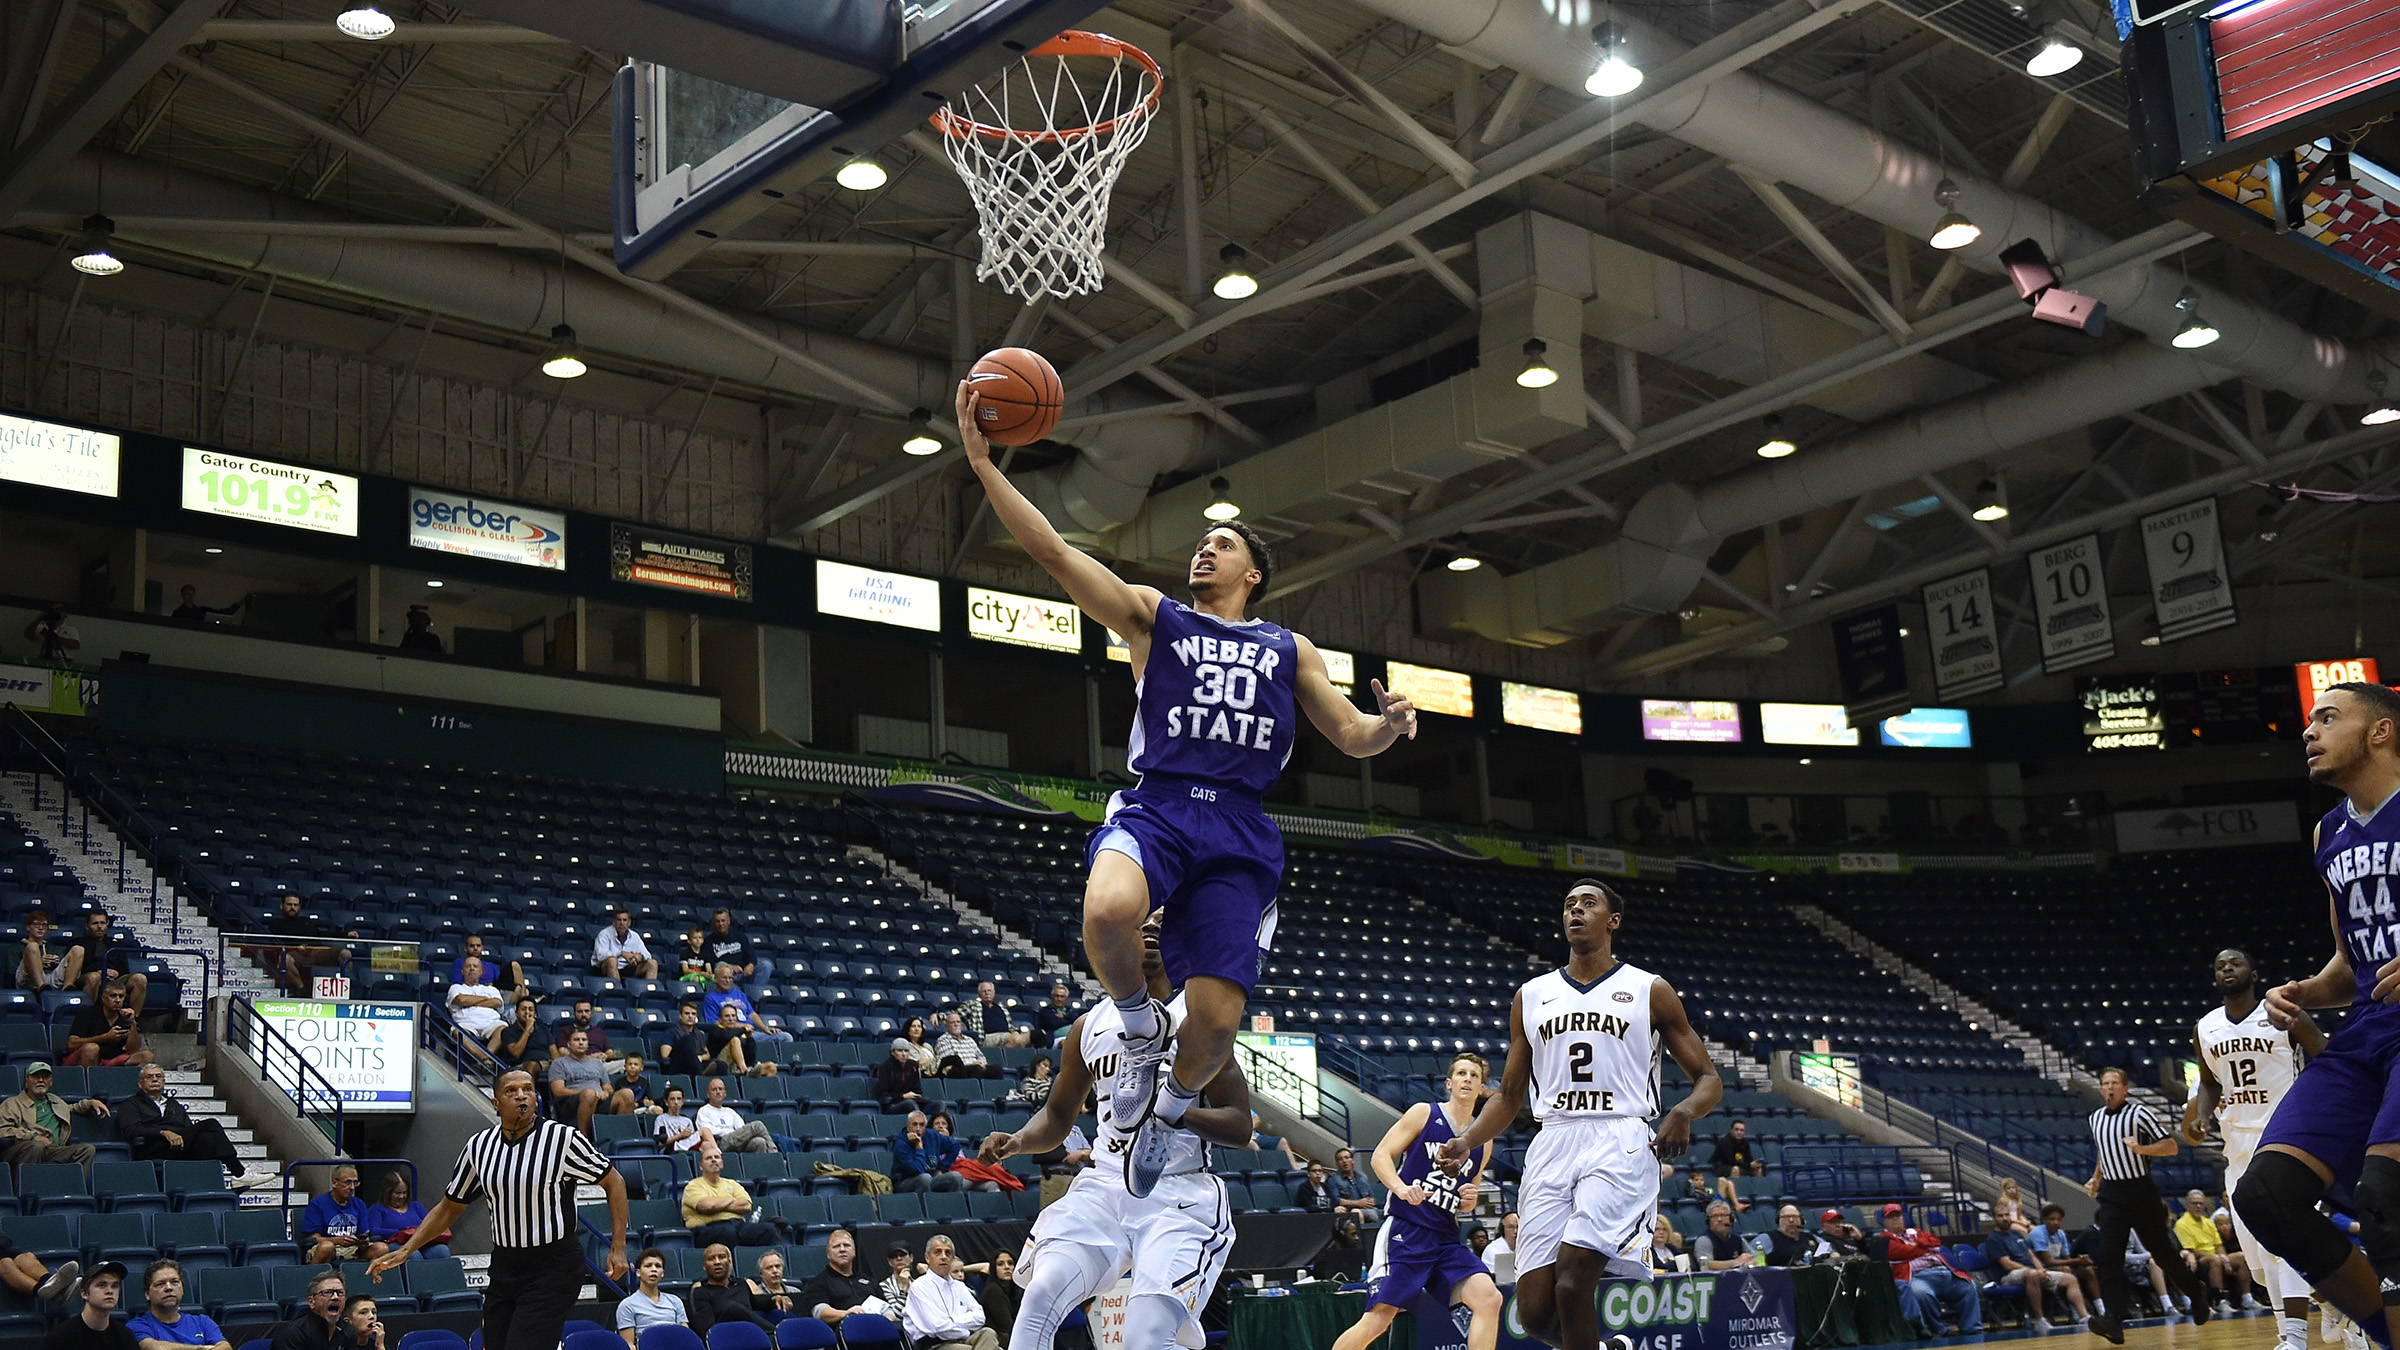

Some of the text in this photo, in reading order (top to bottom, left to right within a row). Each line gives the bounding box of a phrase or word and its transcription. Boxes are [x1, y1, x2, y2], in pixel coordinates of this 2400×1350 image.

[201, 454, 310, 484] Gator Country
[200, 470, 310, 516] 101.9
[314, 511, 339, 522] FM
[413, 498, 521, 533] gerber
[432, 522, 516, 543] COLLISION & GLASS
[412, 537, 441, 551] Highly
[443, 543, 523, 563] Wreck-ommended!
[2044, 544, 2086, 567] BERG
[2172, 531, 2194, 568] 9
[636, 567, 731, 593] GermainAutoImages.com
[865, 577, 893, 590] USA
[1928, 578, 1984, 602] BUCKLEY
[2046, 563, 2091, 605] 10
[849, 588, 911, 607] GRADING
[1939, 595, 1981, 636] 14
[1170, 635, 1280, 681] WEBER
[2309, 661, 2367, 690] BOB
[1192, 663, 1258, 711] 30
[2097, 687, 2155, 708] Jack's
[431, 714, 455, 730] 111
[2098, 706, 2148, 719] Cleaning
[1167, 705, 1276, 752] STATE
[2100, 717, 2146, 730] Services
[1090, 790, 1107, 803] 112
[1190, 786, 1217, 803] CATS
[2202, 809, 2258, 835] FCB
[93, 858, 120, 866] metro
[124, 886, 152, 894] metro
[2349, 877, 2396, 925] 44
[176, 937, 203, 945] metro
[222, 978, 248, 987] metro
[322, 979, 345, 997] EXIT
[231, 989, 260, 998] metro
[264, 1003, 406, 1018] Section 110 111 Section
[284, 1019, 358, 1042] FOUR
[1257, 1017, 1271, 1031] EXIT
[1538, 1011, 1631, 1046] MURRAY
[1248, 1036, 1261, 1045] 111
[1275, 1036, 1290, 1046] 112
[2209, 1038, 2275, 1060] MURRAY
[284, 1046, 385, 1070] POINTS
[1569, 1042, 1594, 1083] 2
[307, 1072, 385, 1085] SERATON
[2230, 1058, 2257, 1088] 12
[1553, 1090, 1614, 1111] STATE
[2228, 1090, 2269, 1105] STATE
[1604, 1278, 1714, 1331] COAST
[1728, 1316, 1781, 1333] MIROMAR
[1728, 1331, 1787, 1350] OUTLETS
